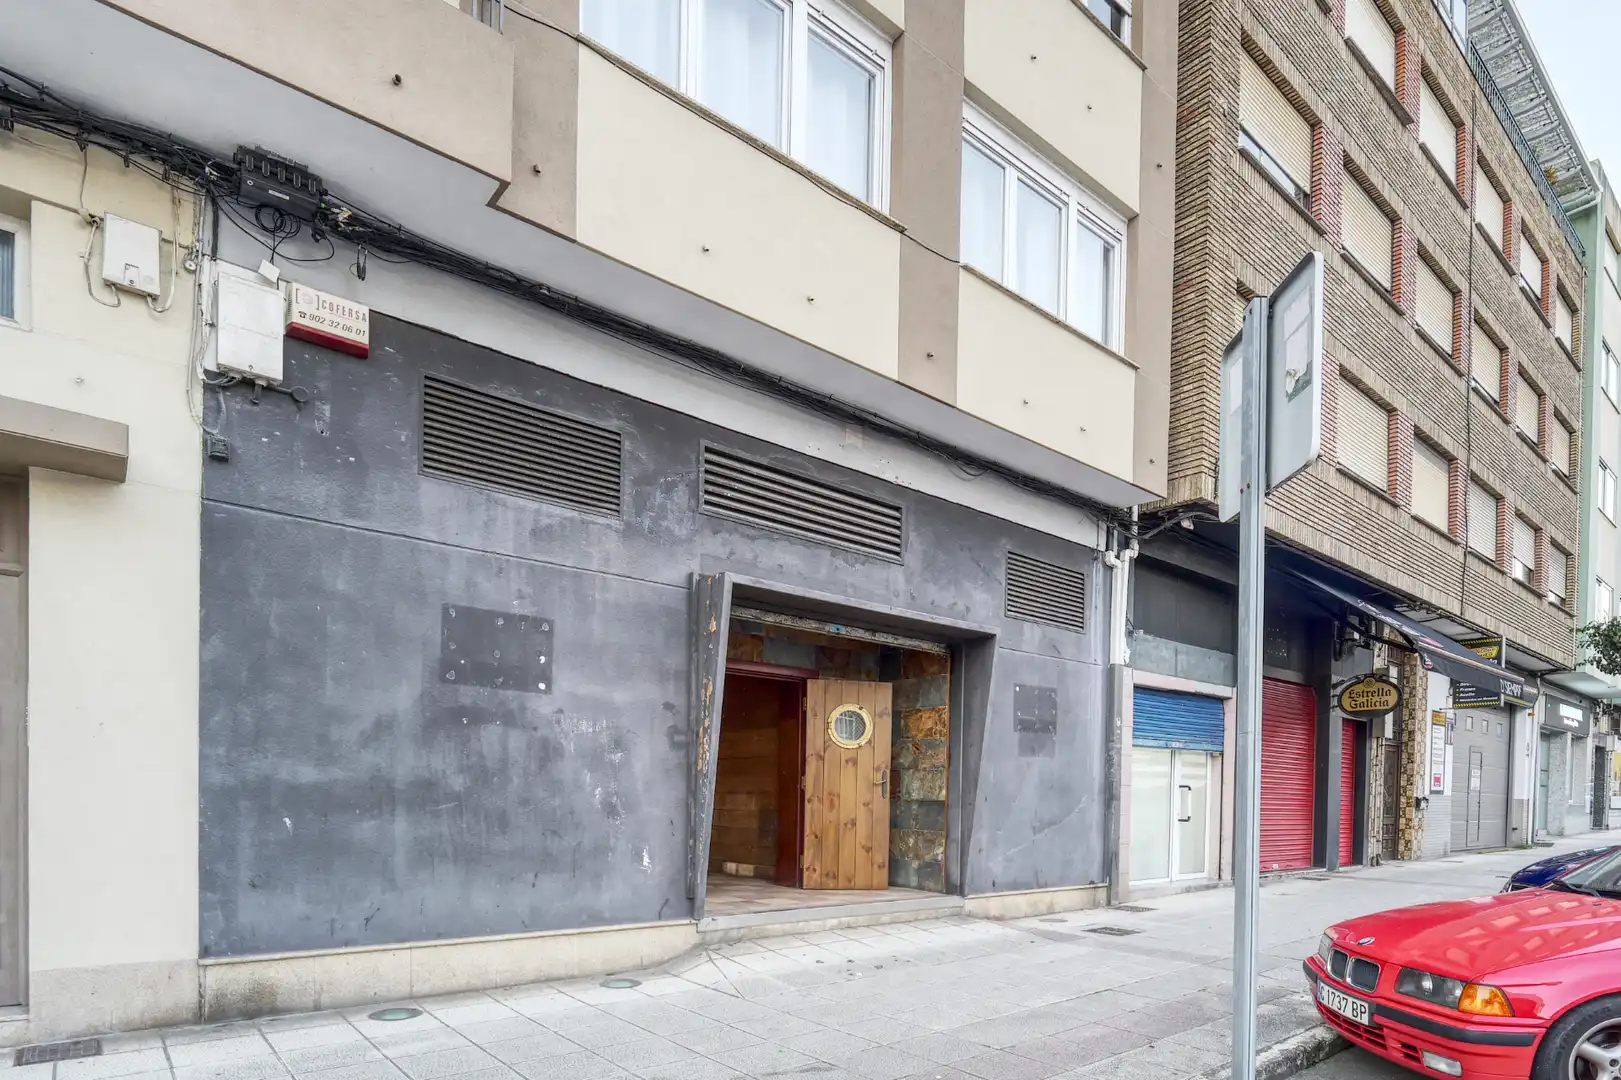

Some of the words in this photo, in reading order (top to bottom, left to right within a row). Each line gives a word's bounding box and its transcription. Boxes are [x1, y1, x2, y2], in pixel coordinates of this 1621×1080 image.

[321, 299, 367, 323] COFERSA
[309, 314, 326, 324] 902
[328, 319, 340, 329] 32
[342, 324, 353, 333] 06
[355, 328, 366, 337] 01
[1348, 687, 1392, 699] Estrella
[1349, 698, 1389, 709] Galicia
[1320, 986, 1325, 1001] C
[1327, 989, 1348, 1013] 1737
[1351, 1001, 1367, 1020] BP
